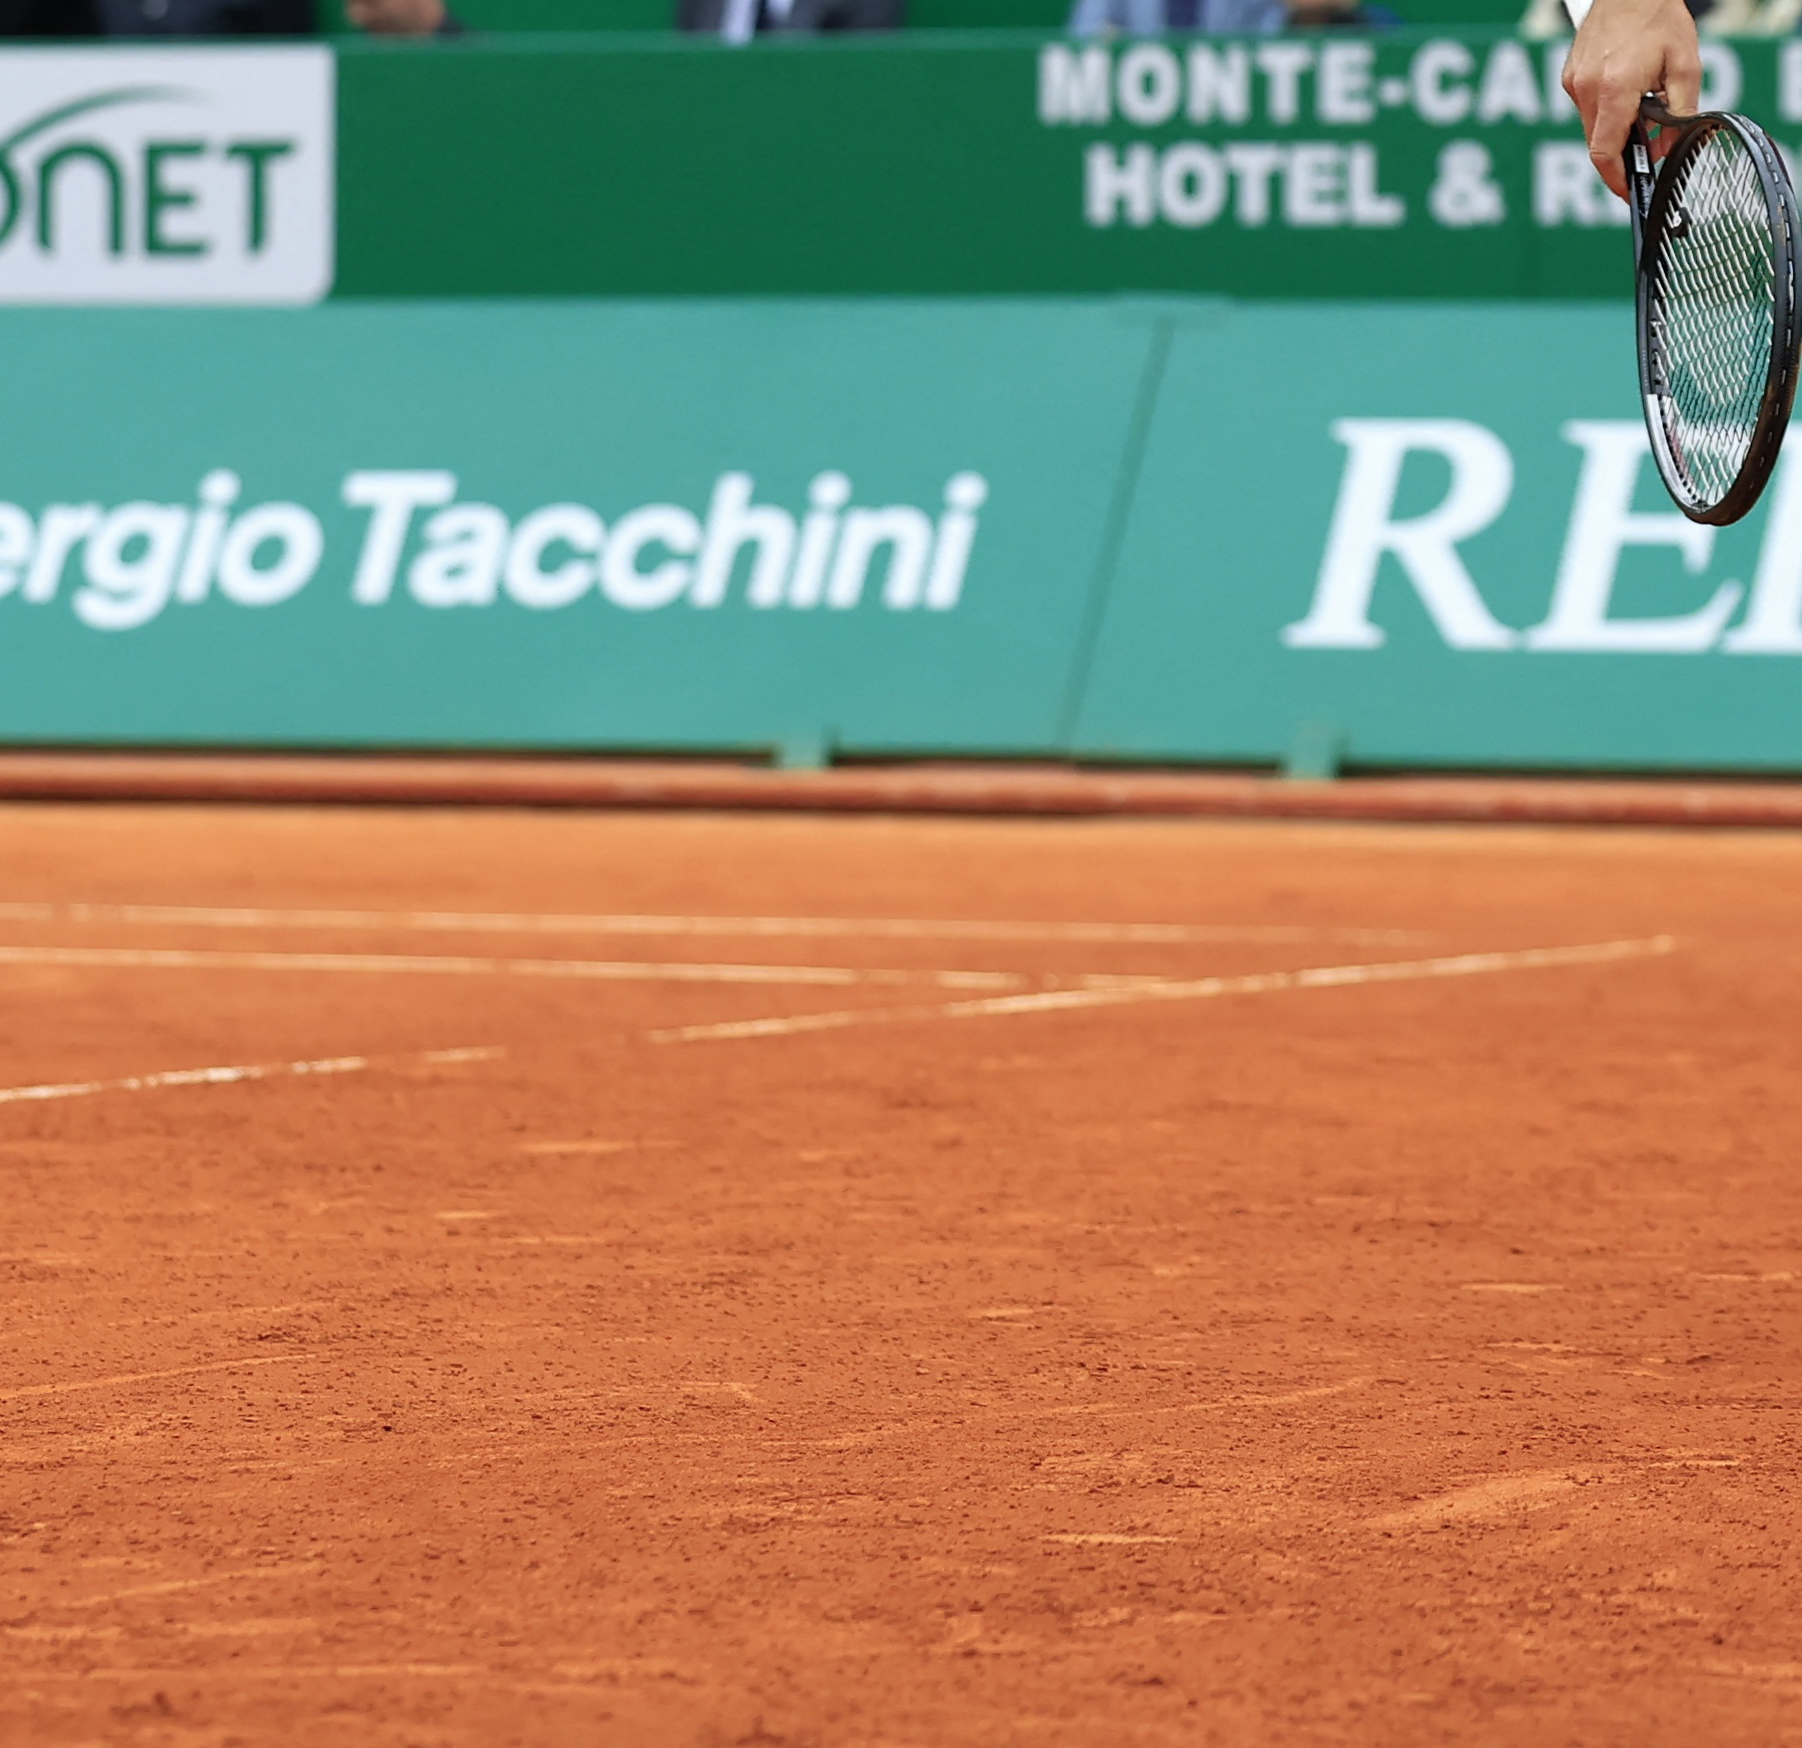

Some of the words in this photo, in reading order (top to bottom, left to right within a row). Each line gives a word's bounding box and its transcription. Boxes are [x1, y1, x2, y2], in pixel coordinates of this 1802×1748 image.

[1083, 138, 1405, 228] HOTEL
[1429, 138, 1505, 228] &
[343, 469, 988, 612] Tacchini
